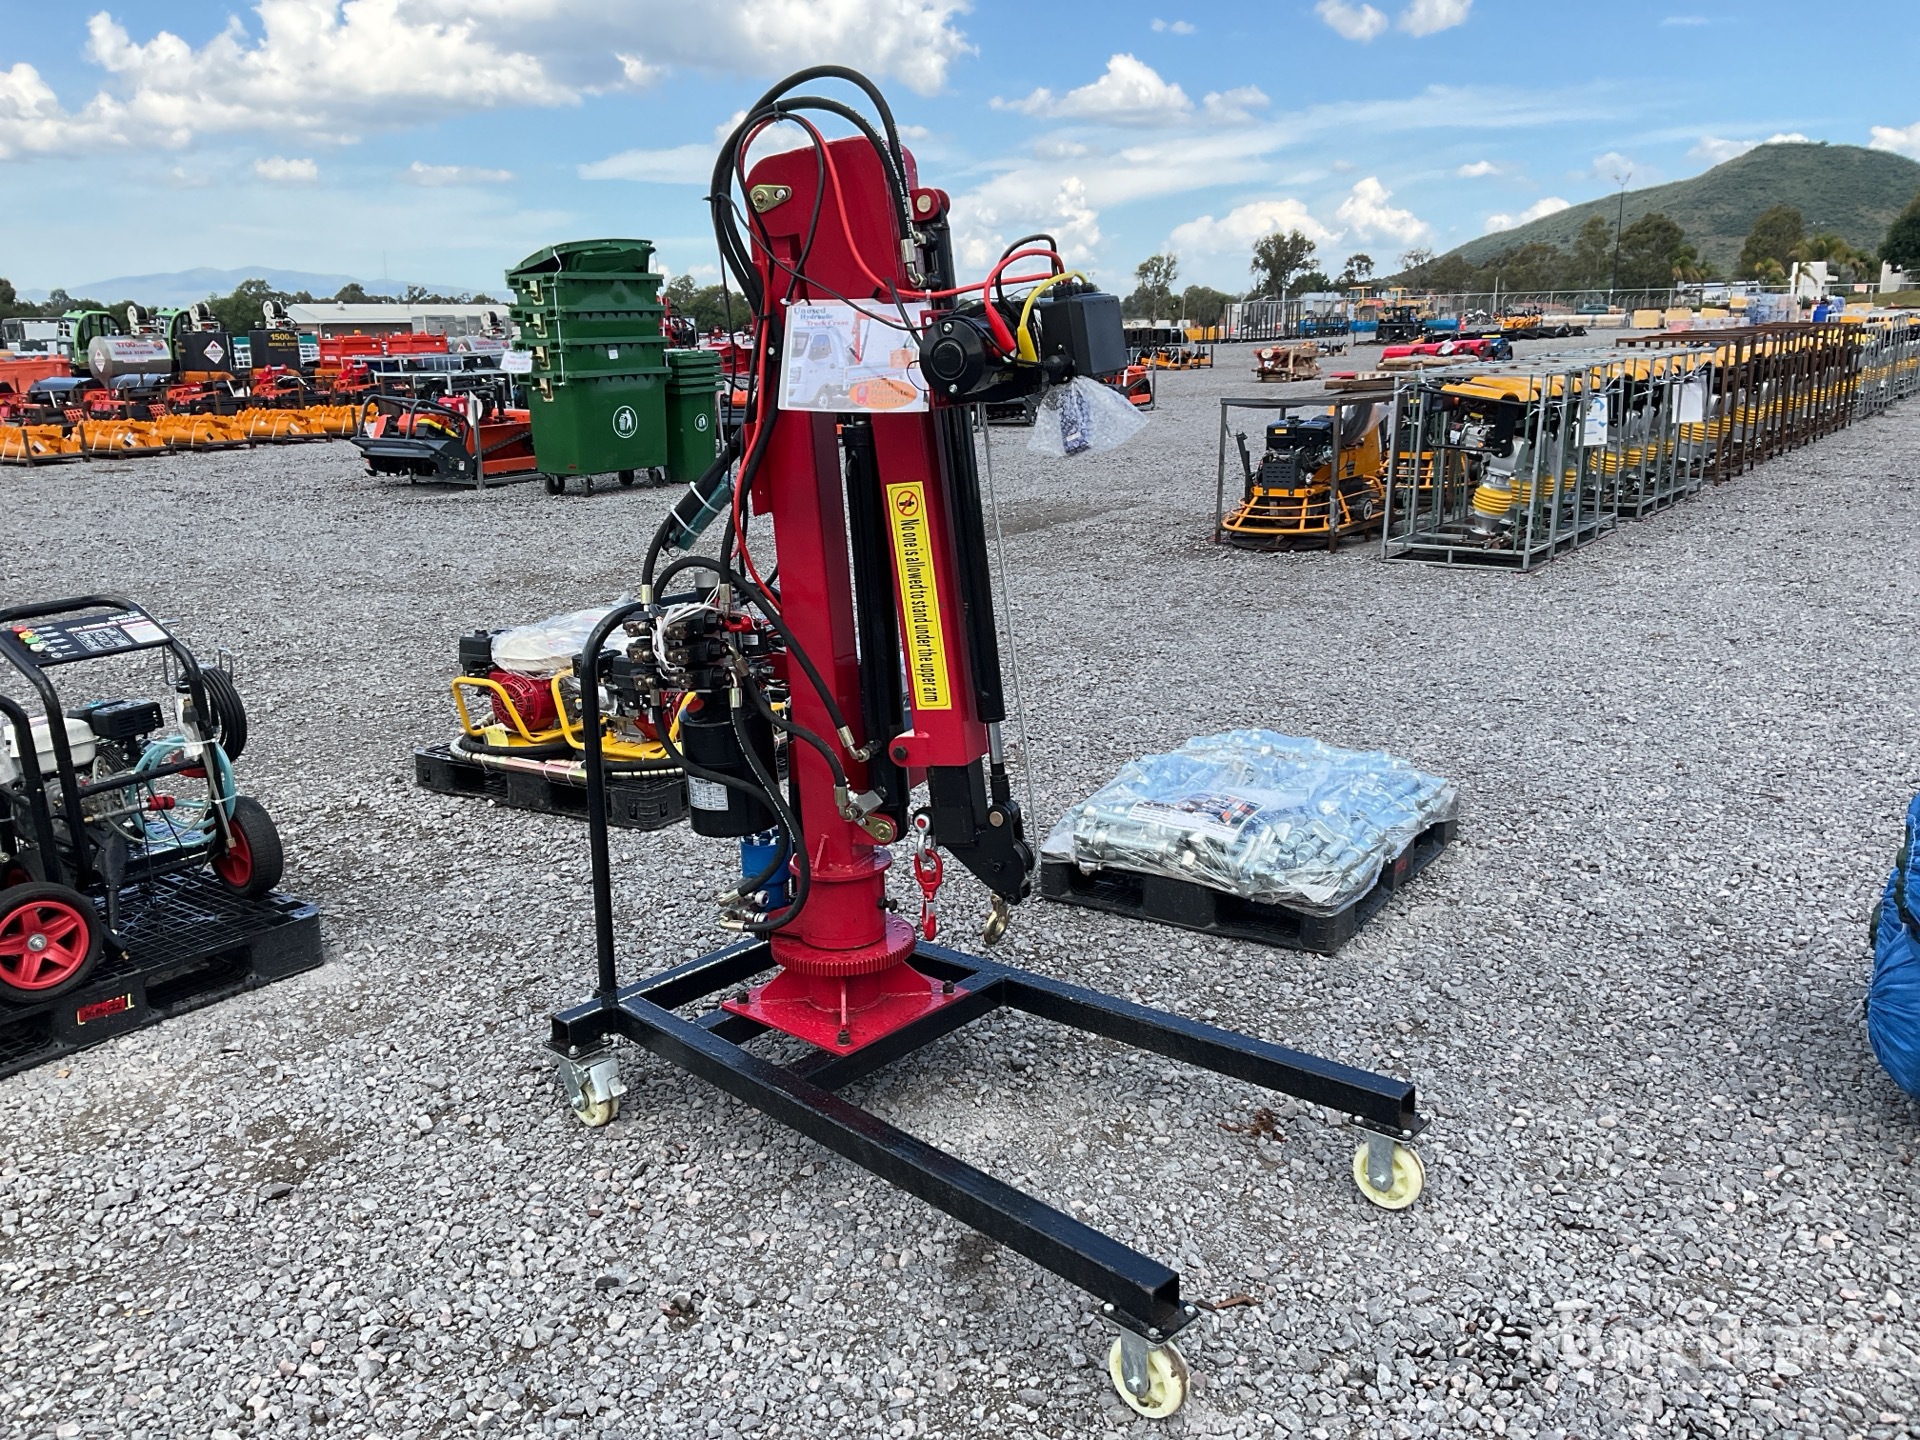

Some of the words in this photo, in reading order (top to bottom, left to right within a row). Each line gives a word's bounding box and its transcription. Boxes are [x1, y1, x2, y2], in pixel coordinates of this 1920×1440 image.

[270, 333, 290, 341] 1500
[870, 396, 908, 404] Control
[900, 518, 920, 531] No
[902, 532, 918, 548] one
[904, 548, 923, 556] is
[905, 557, 929, 589] allowed
[910, 589, 927, 599] to
[911, 600, 933, 623] stand
[914, 624, 935, 647] under
[917, 649, 938, 662] the
[915, 663, 936, 686] upper
[922, 687, 938, 703] arm
